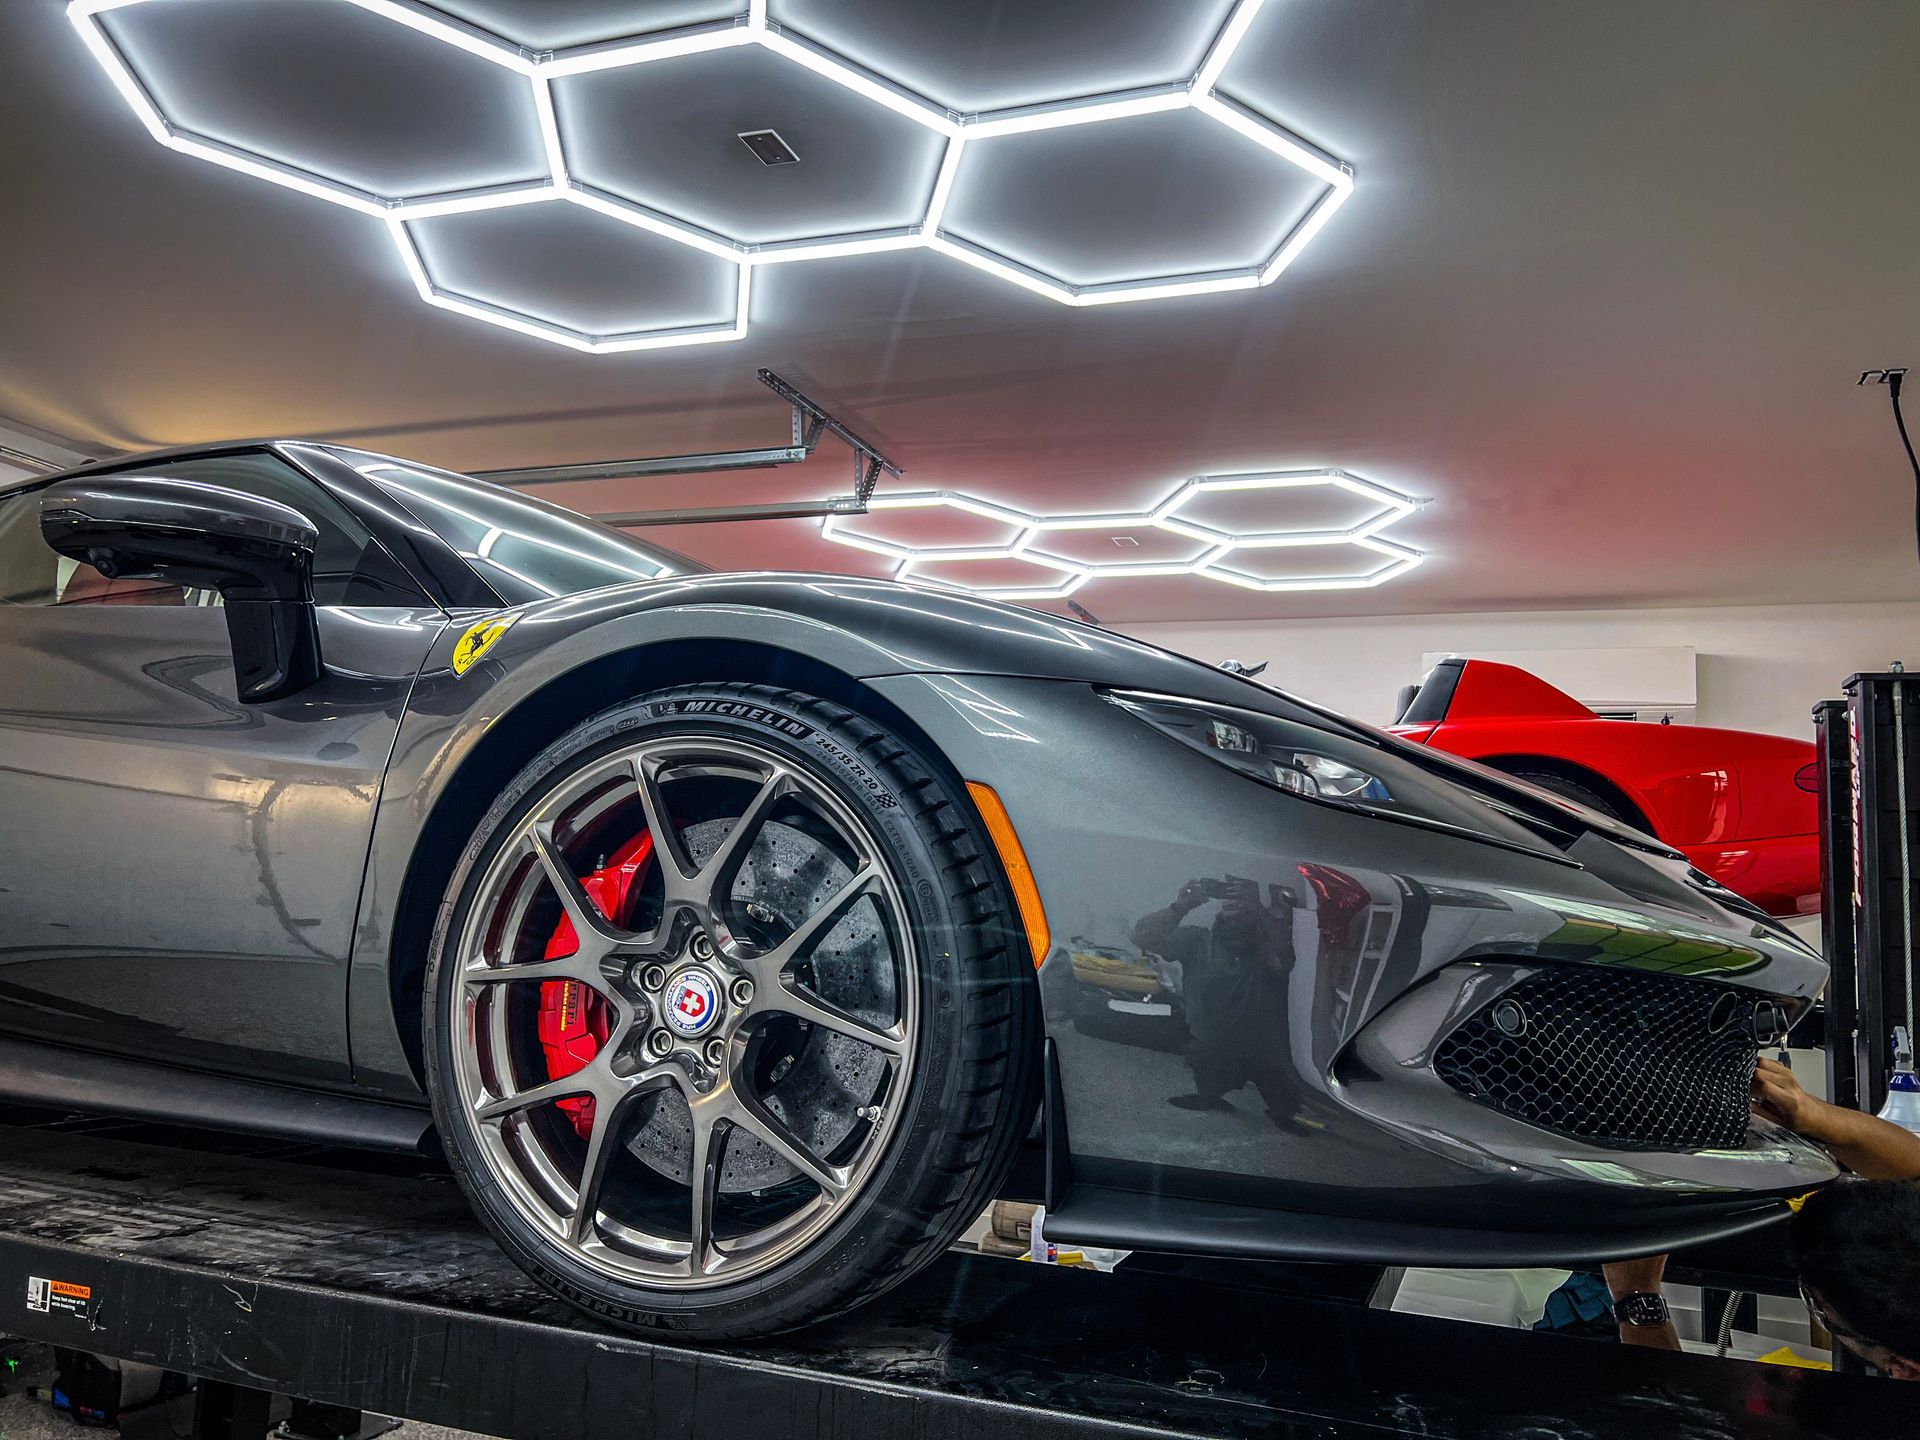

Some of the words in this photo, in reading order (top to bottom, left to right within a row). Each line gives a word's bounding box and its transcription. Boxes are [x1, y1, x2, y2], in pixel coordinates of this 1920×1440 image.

[684, 701, 806, 736] MICHELIN
[815, 738, 853, 765] 245/35
[850, 762, 868, 778] ZR
[862, 776, 879, 791] 20
[884, 818, 906, 851] EXTRA
[902, 850, 919, 878] LOAD
[58, 1284, 89, 1296] WARNING
[540, 1270, 656, 1327] MICHELIN
